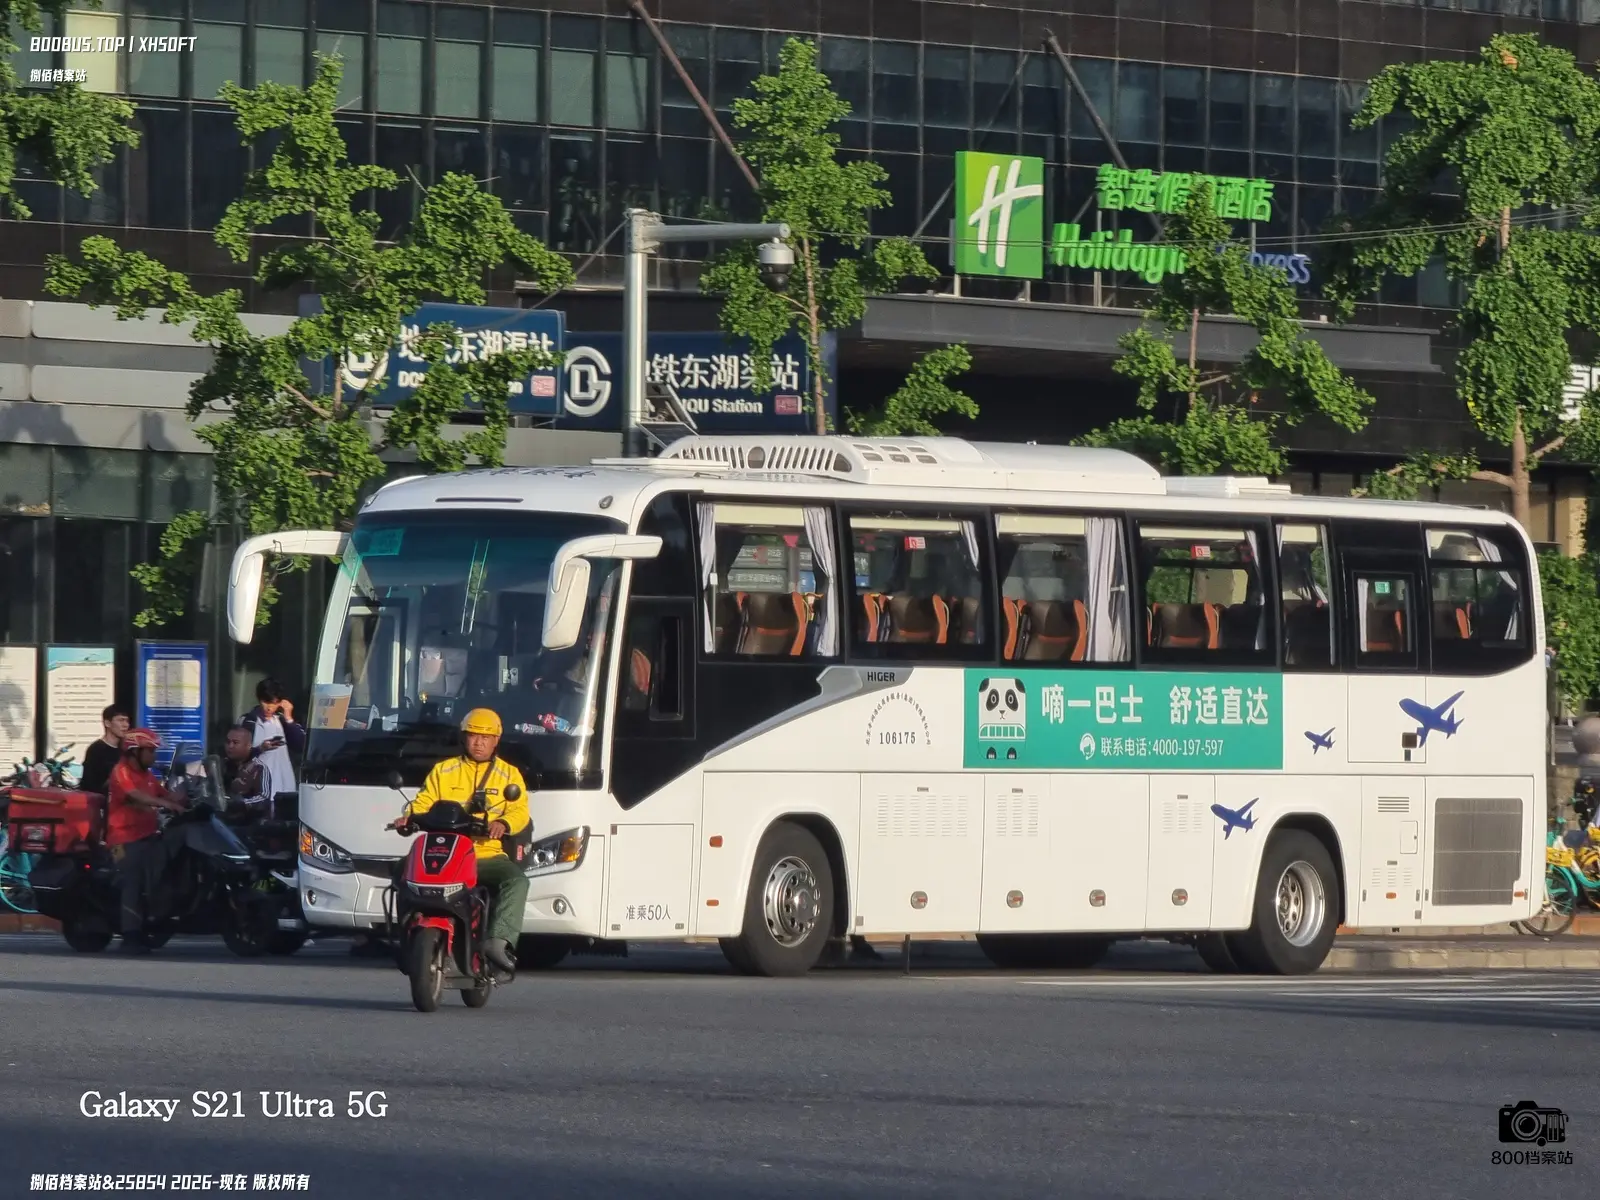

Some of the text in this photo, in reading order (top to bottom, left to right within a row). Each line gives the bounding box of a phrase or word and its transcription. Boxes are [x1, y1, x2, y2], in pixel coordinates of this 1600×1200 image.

[1096, 163, 1275, 223] 智选假酒店
[1051, 223, 1166, 284] Holiday
[398, 323, 556, 371] 地东湖渠站
[712, 398, 763, 414] Station
[867, 672, 896, 682] HIGER
[1041, 684, 1269, 725] 嘀一巴士 舒适直达
[879, 731, 916, 745] 106175
[1100, 736, 1224, 757] 联系电话:4000-197-597
[626, 904, 671, 921] 准乘50人
